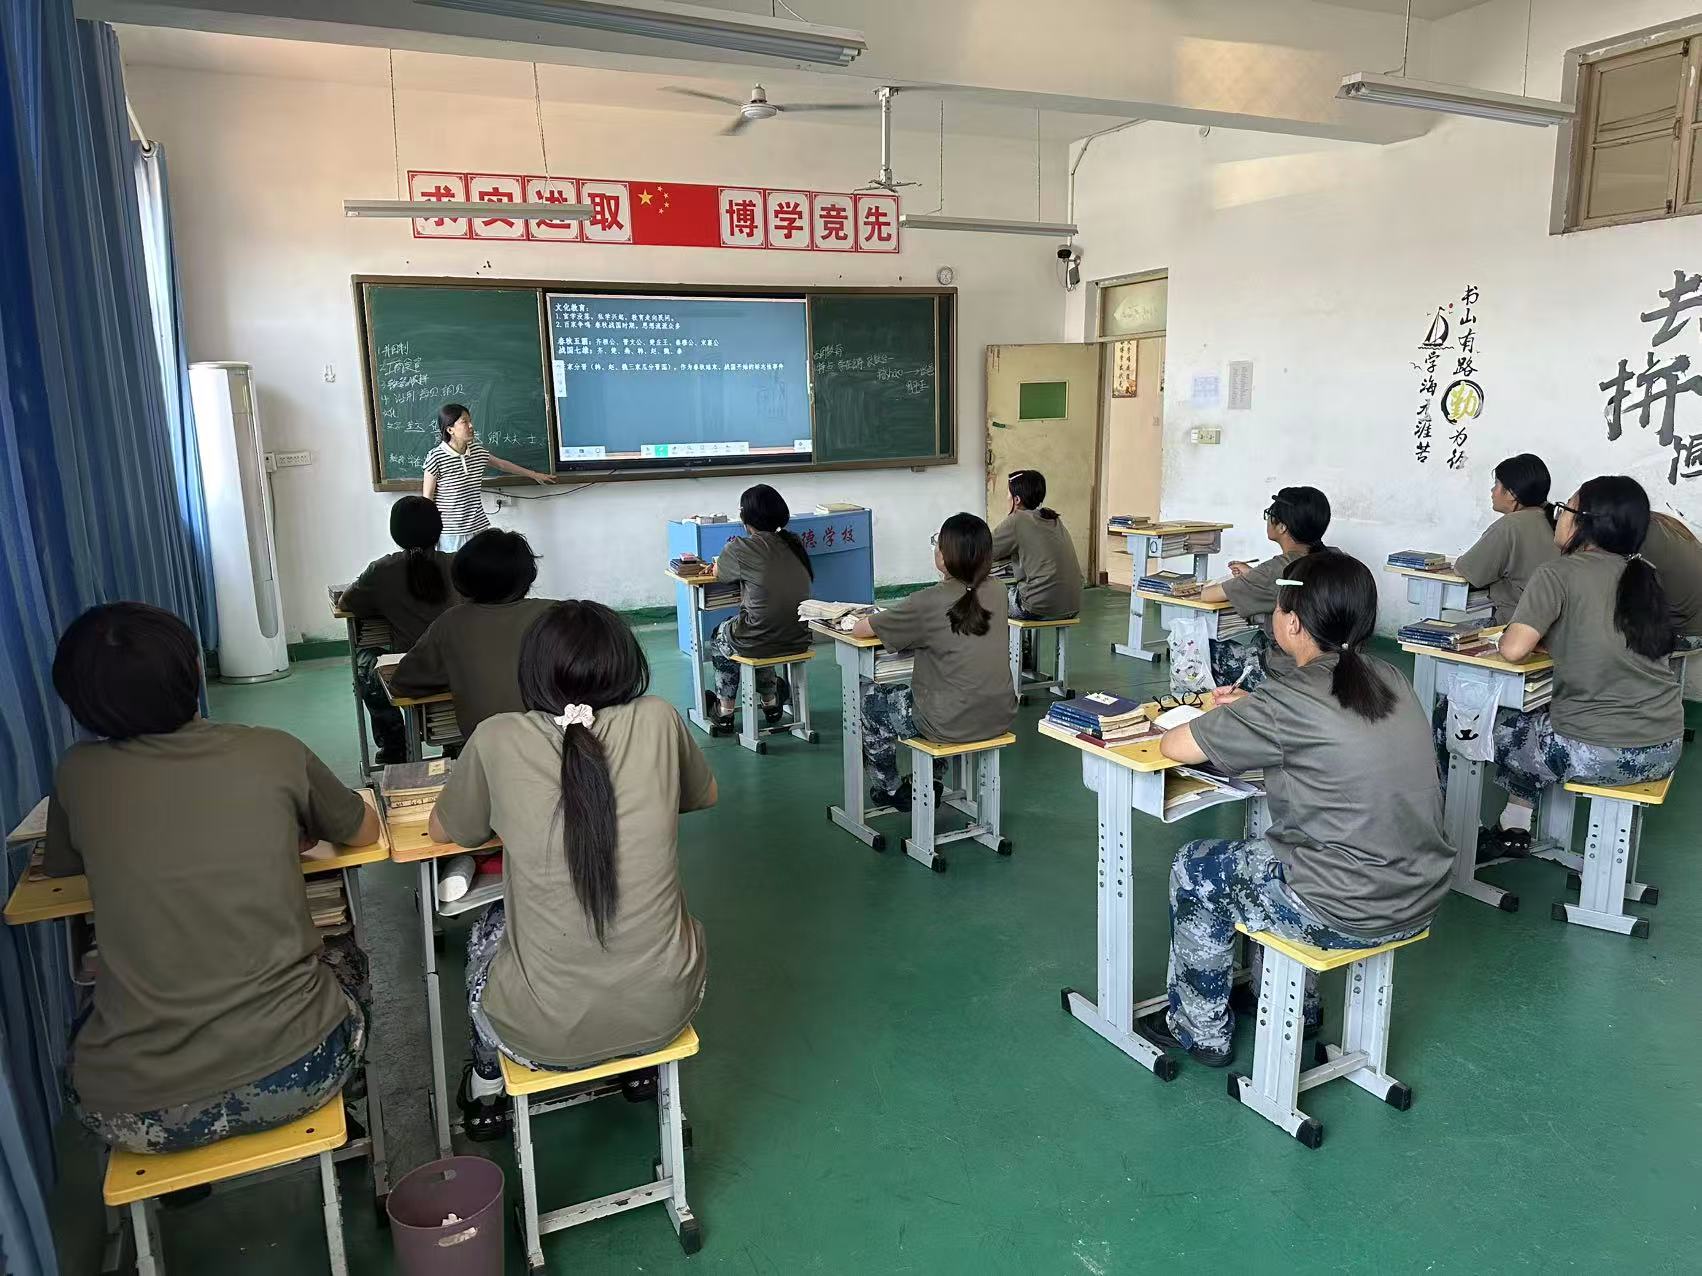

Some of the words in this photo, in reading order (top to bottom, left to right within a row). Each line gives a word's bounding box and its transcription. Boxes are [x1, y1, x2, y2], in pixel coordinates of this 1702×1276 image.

[726, 199, 892, 242] 博学竞先
[1447, 285, 1480, 469] 书山有路勤为径
[1600, 352, 1702, 447] 拼
